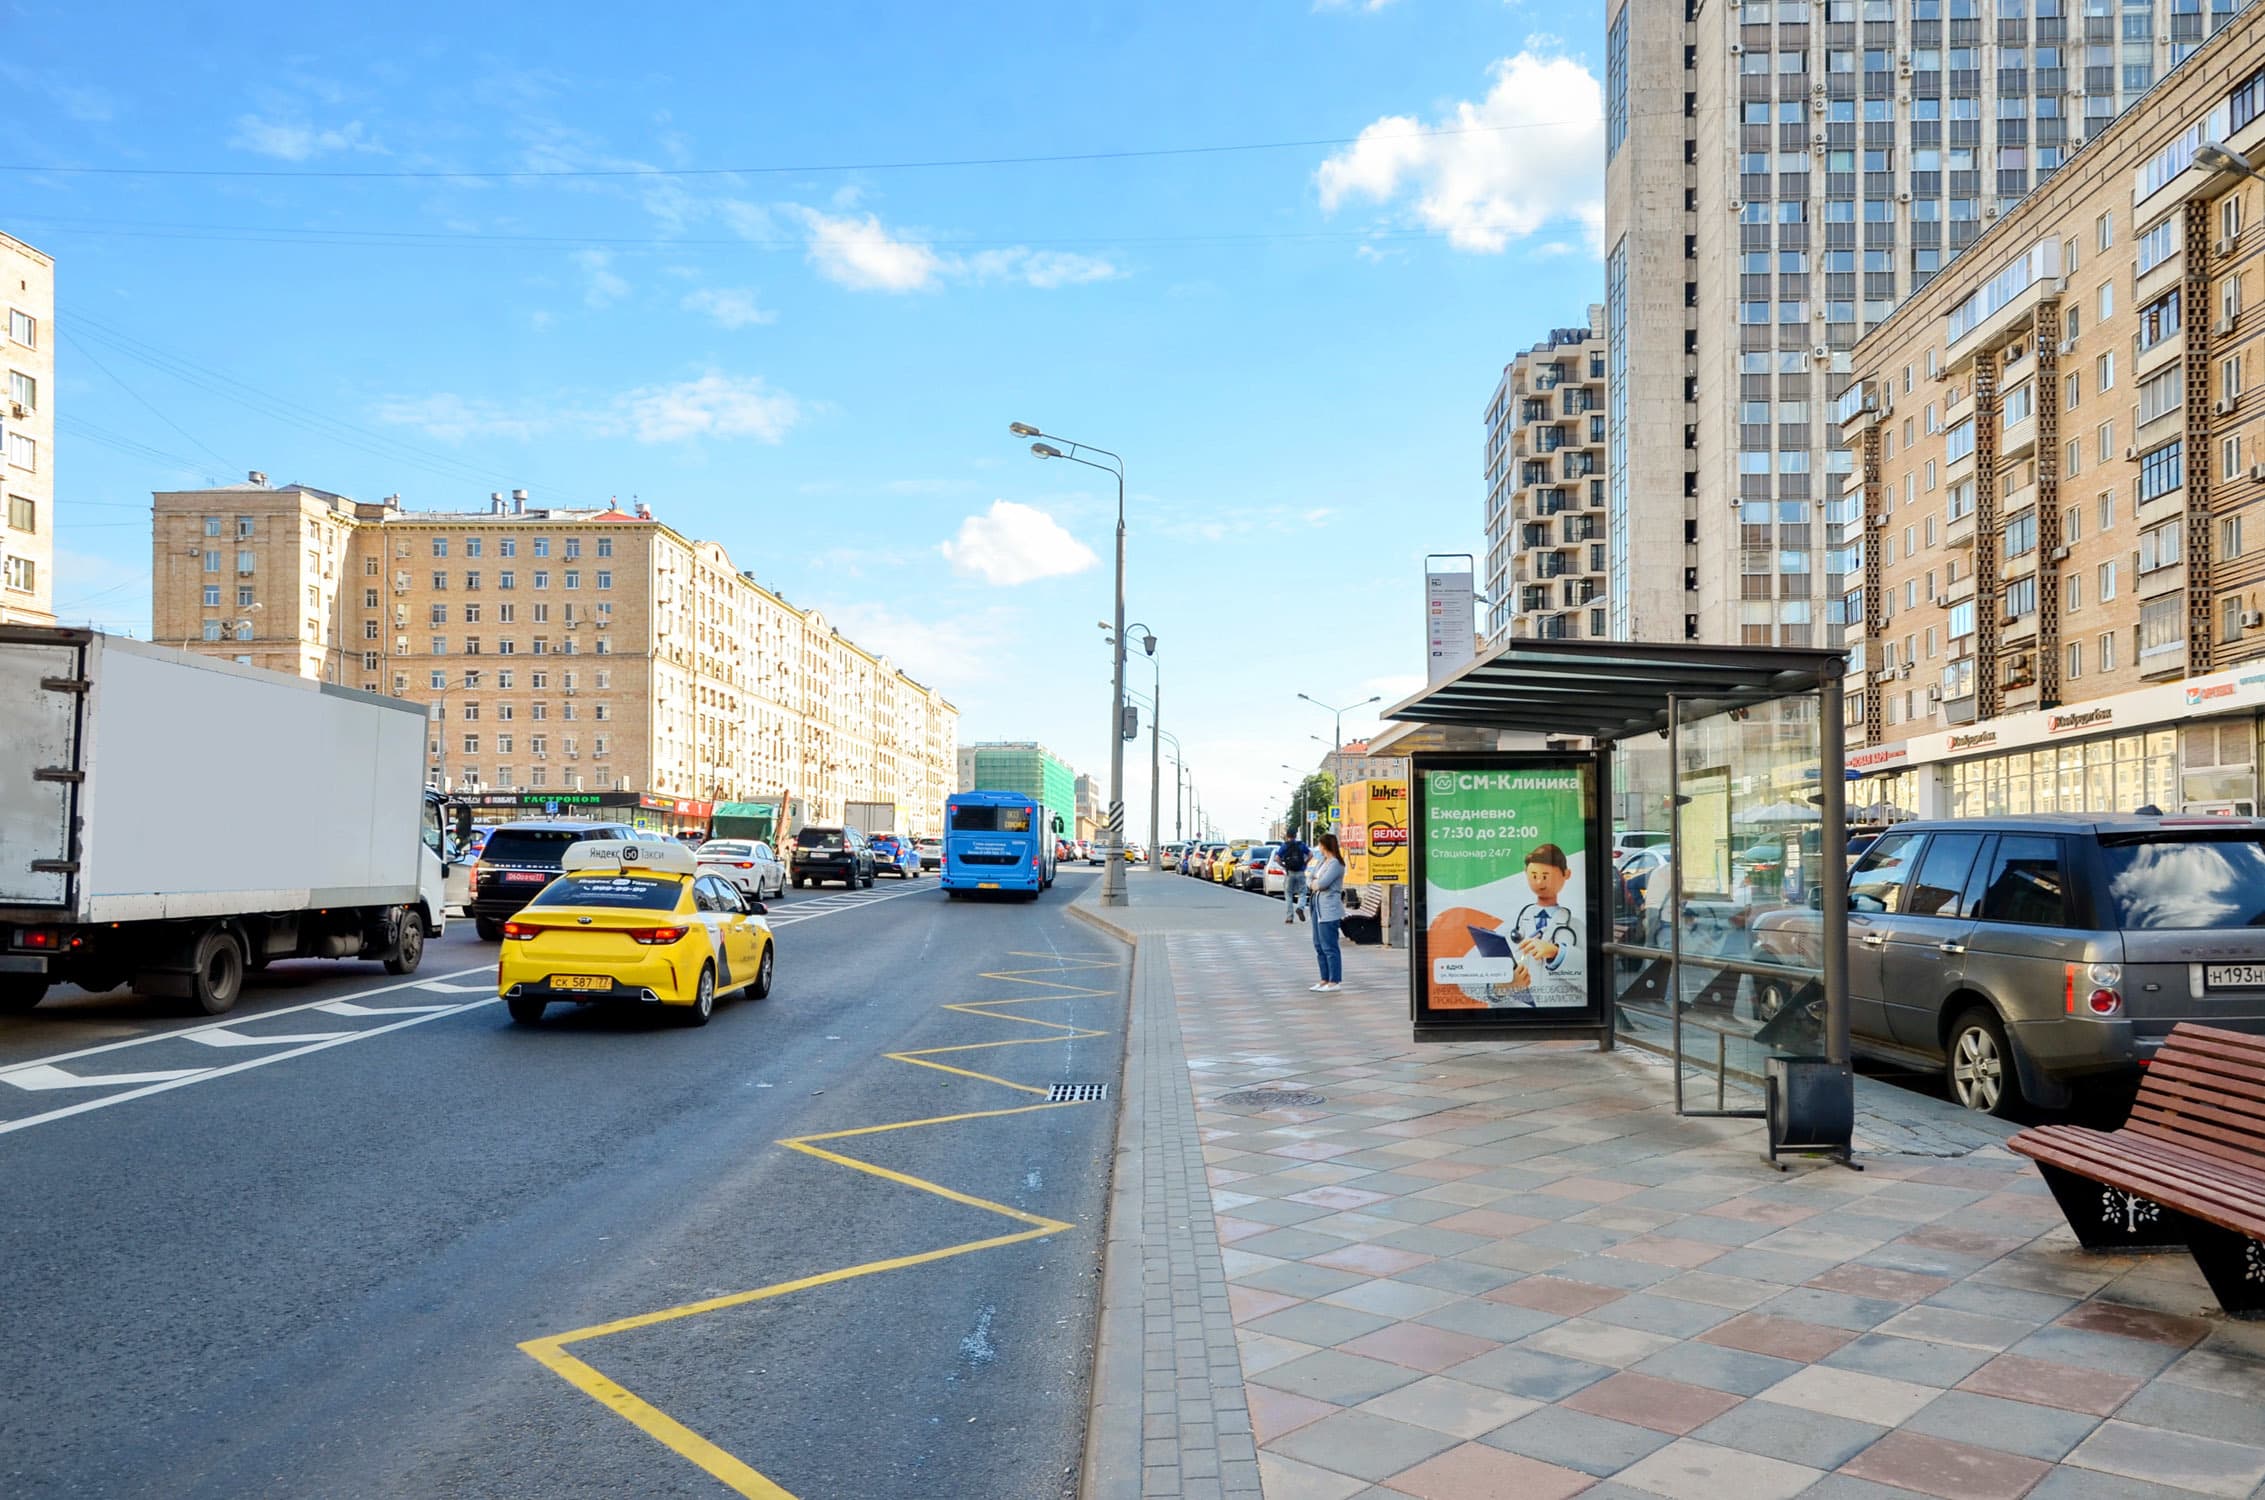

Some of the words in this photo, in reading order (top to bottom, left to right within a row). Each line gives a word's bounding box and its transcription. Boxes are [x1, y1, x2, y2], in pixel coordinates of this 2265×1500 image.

[1459, 774, 1579, 790] СМ-Клиника
[523, 795, 600, 803] ГАСТРОНОМ
[1431, 807, 1516, 820] Ежедневно
[1431, 829, 1439, 839] с
[1442, 826, 1474, 839] 7:30
[1476, 829, 1496, 840] до
[1499, 826, 1538, 838] 22:00
[590, 847, 620, 859] Яндекс
[624, 846, 637, 859] Go
[641, 848, 665, 859] Такси
[1431, 849, 1487, 859] Стационар
[1488, 848, 1512, 857] 24/7
[2212, 967, 2265, 983] Н193Н
